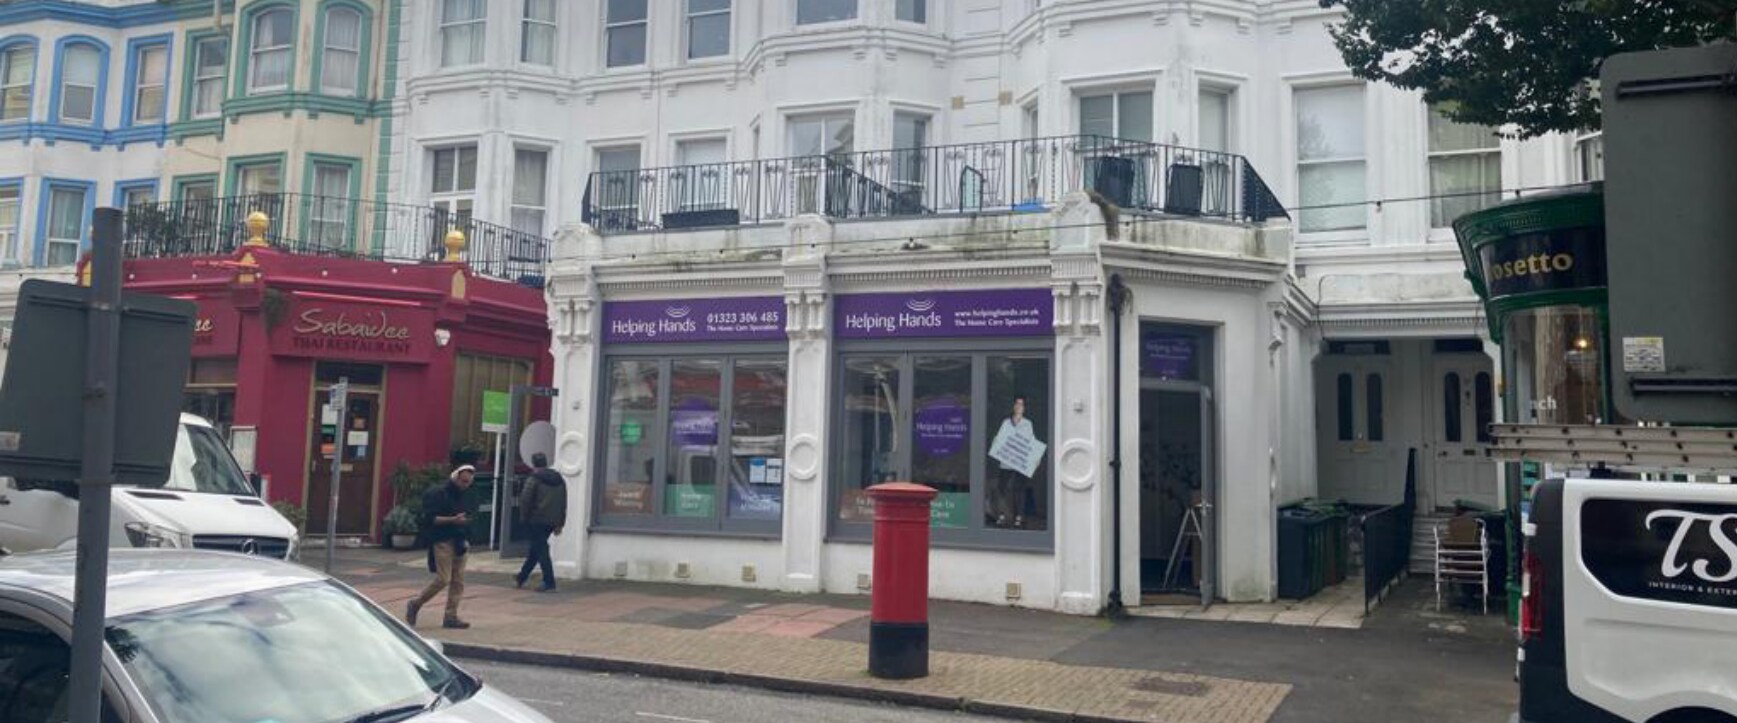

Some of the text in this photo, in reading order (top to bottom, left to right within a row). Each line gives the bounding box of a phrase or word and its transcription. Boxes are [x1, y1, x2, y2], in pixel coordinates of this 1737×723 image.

[706, 311, 779, 323] 01323 306 485
[845, 311, 942, 332] Helping Hands
[987, 318, 1004, 326] Care
[612, 318, 696, 337] Helping Hands
[292, 337, 413, 355] THAI RESTAURANT
[1649, 581, 1694, 592] INTERIOR
